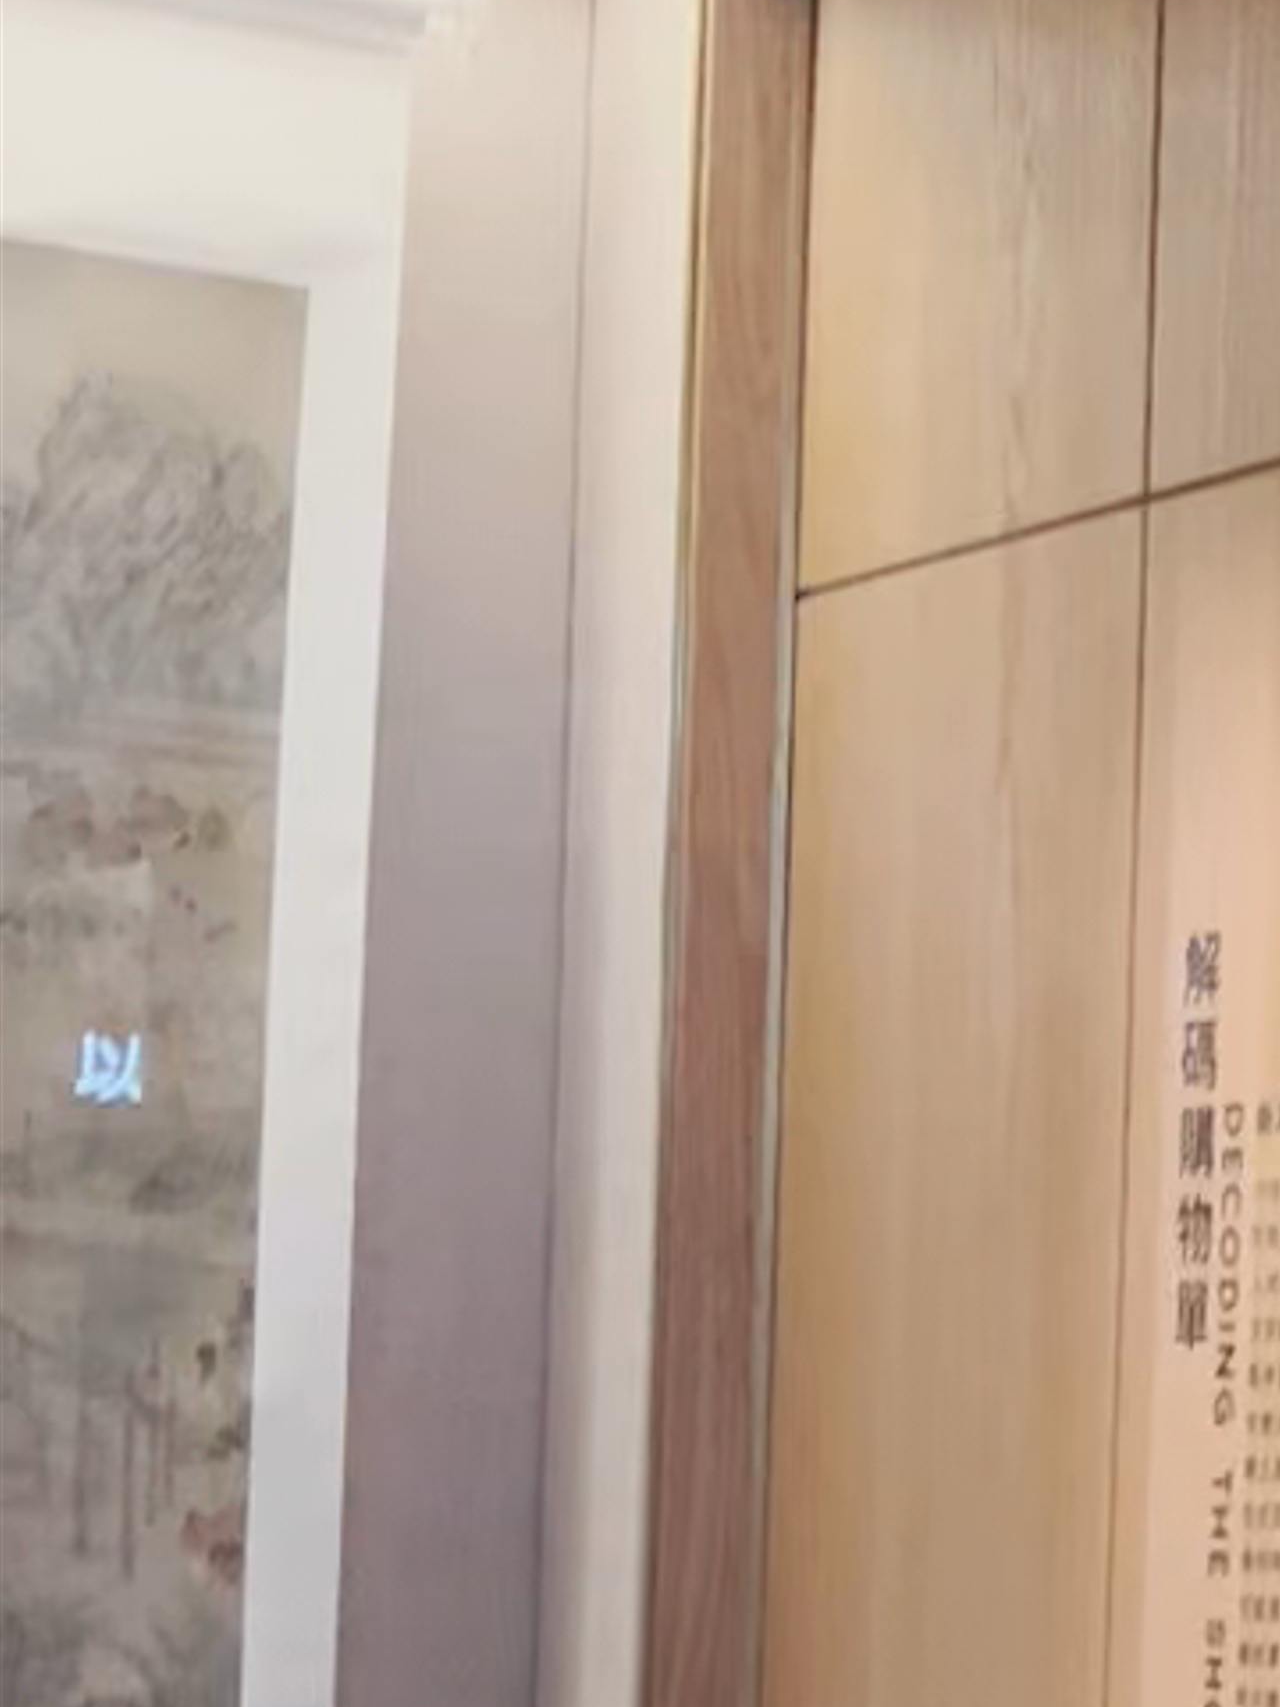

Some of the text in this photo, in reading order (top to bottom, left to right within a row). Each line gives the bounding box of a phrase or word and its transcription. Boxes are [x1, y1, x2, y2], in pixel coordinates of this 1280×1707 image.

[1175, 930, 1221, 1351] 解碼購物單
[1212, 1102, 1245, 1426] DECODING
[1207, 1469, 1234, 1578] THE
